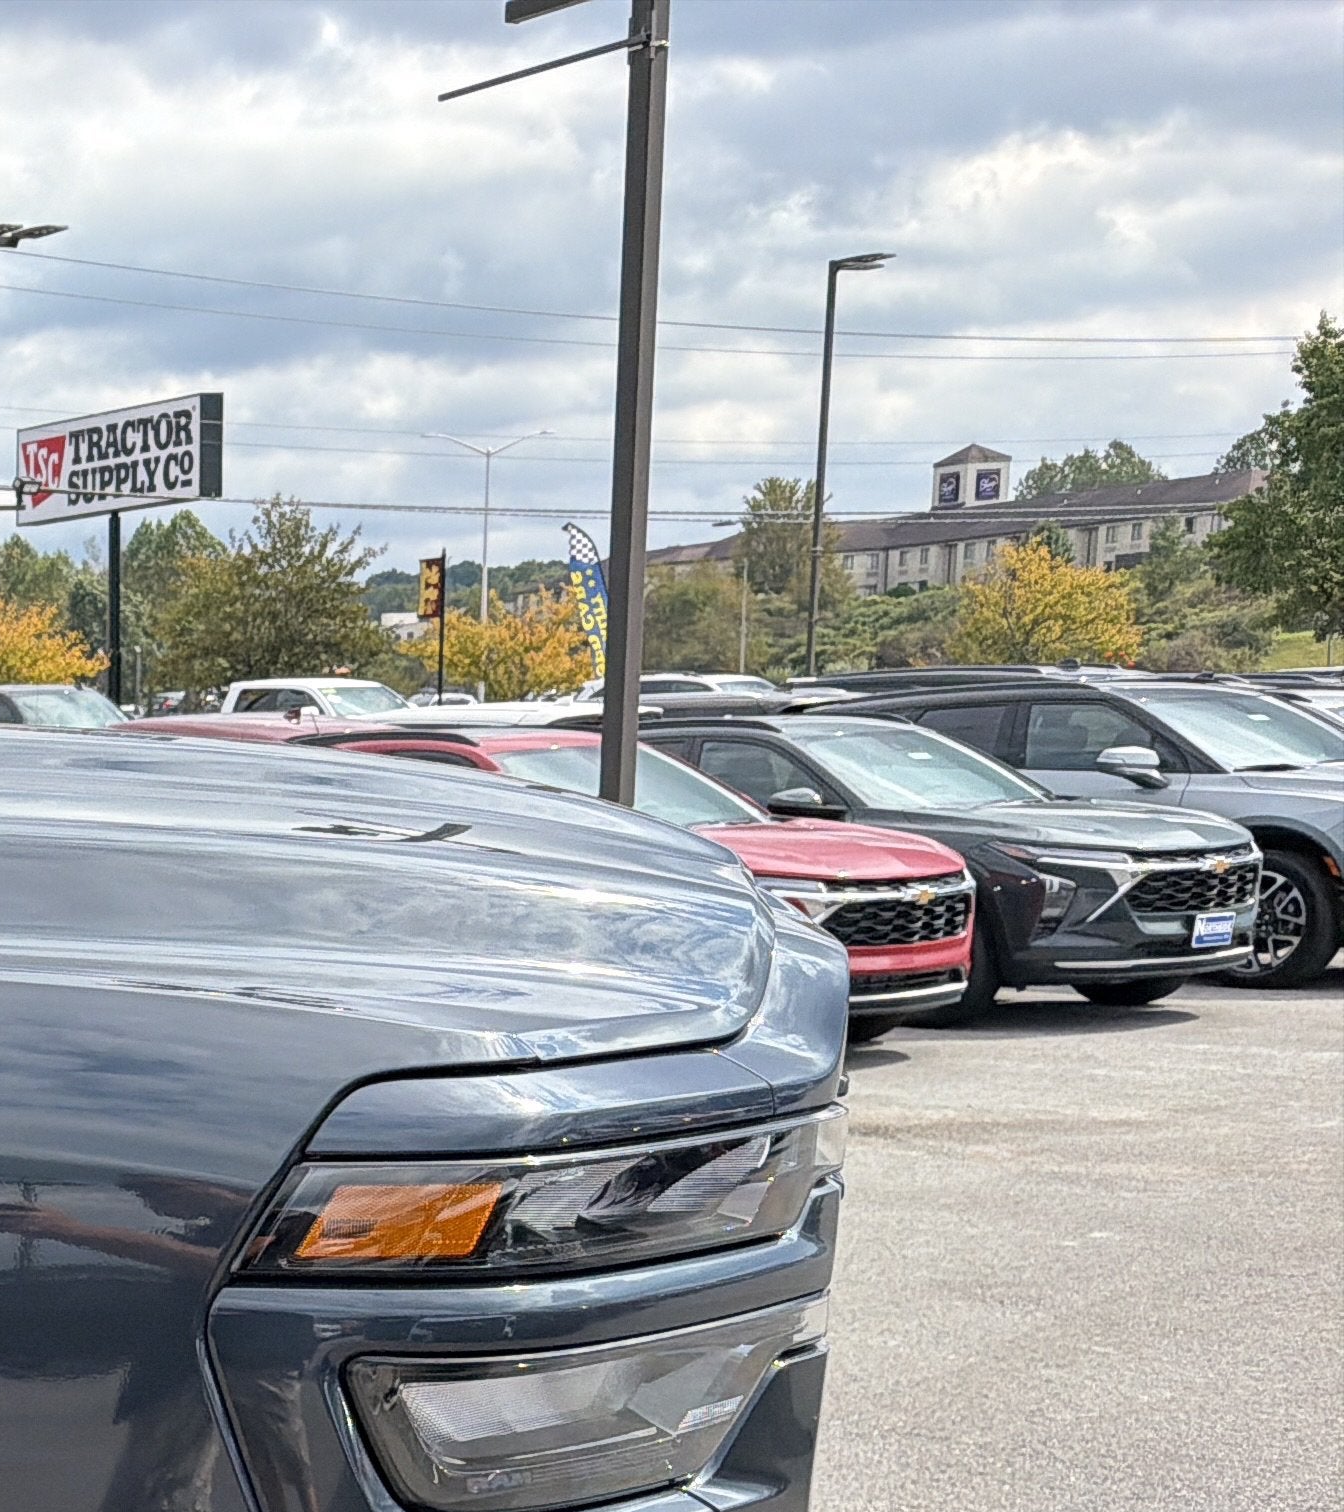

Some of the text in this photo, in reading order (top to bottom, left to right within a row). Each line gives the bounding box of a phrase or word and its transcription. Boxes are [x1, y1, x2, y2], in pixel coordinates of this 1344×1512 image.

[69, 409, 194, 466] TRACTOR
[26, 443, 59, 488] TSC
[67, 455, 161, 507] SUPPLY
